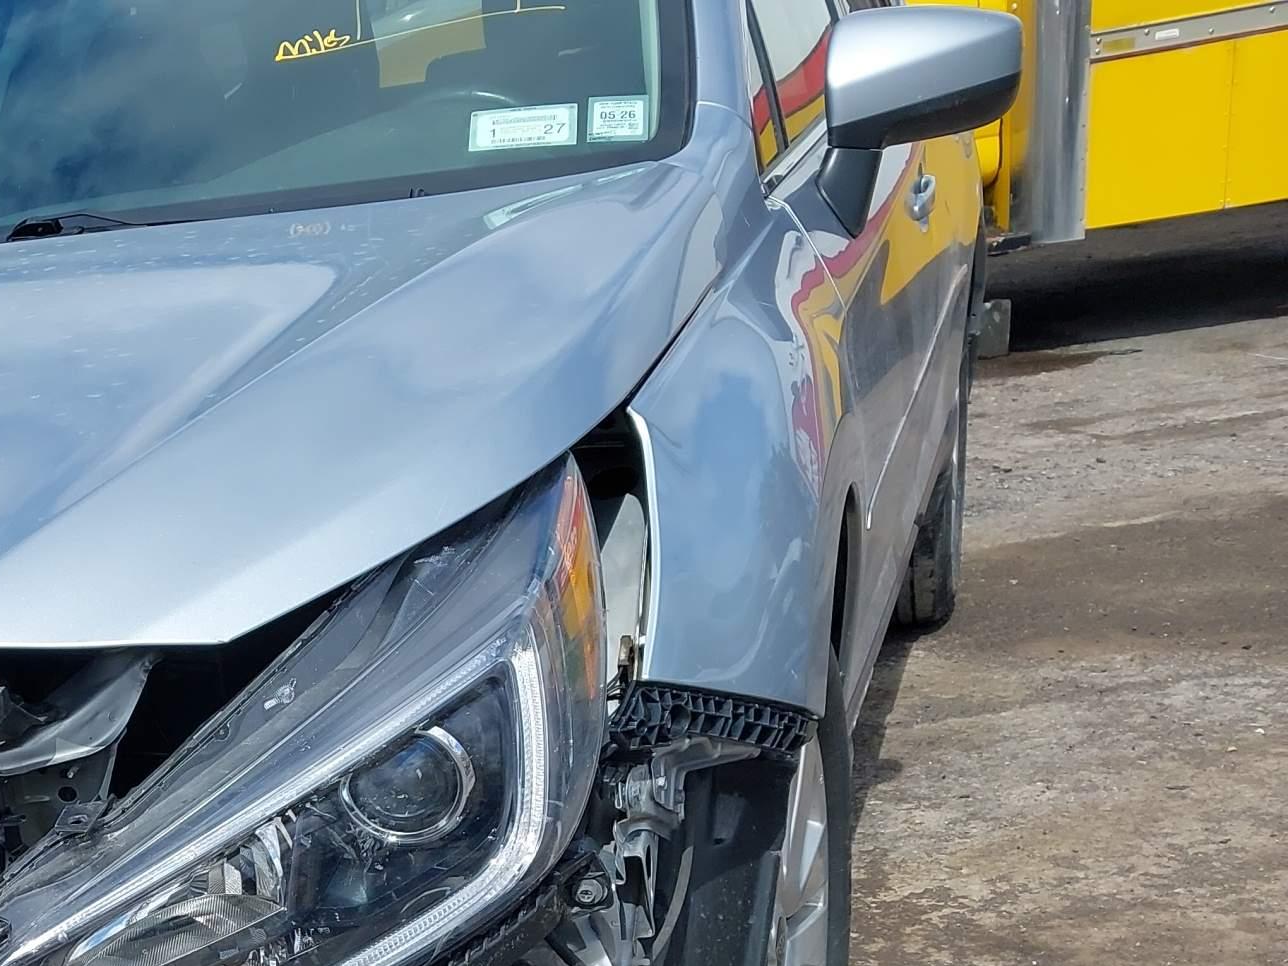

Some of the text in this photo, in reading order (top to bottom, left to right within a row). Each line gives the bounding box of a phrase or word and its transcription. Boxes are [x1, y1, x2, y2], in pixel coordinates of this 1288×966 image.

[600, 110, 636, 120] 05 26
[543, 122, 566, 135] 27
